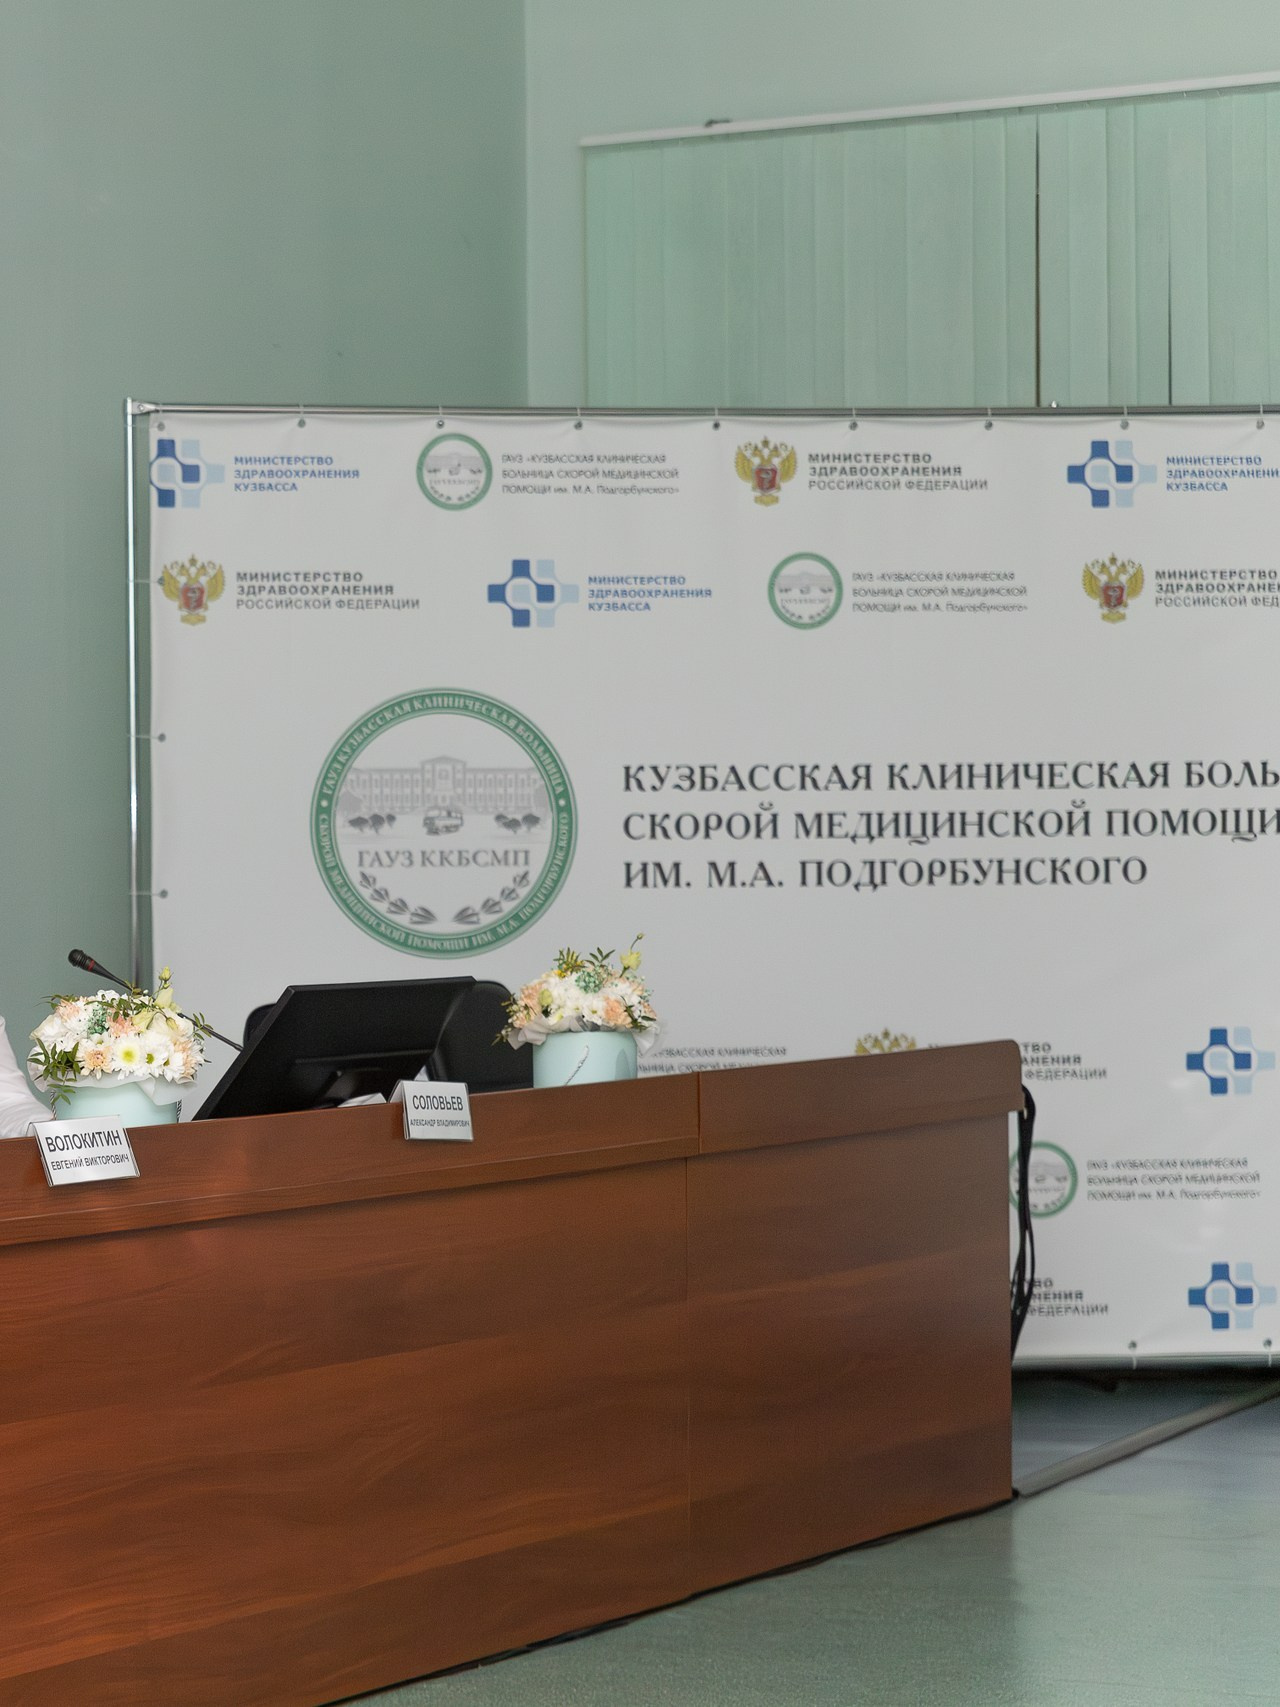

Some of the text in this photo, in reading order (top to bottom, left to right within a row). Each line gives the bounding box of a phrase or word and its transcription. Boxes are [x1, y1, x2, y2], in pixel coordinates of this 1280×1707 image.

[234, 456, 334, 466] МИНИСТЕРСТВО
[597, 453, 666, 464] КЛИНИЧЕСКАЯ
[808, 453, 932, 464] МИНИСТЕРСТВО
[1166, 456, 1262, 466] МИНИСТЕРСТВО
[234, 469, 360, 480] ЗДРАВООХРАНЕНИЯ
[502, 468, 679, 480] БОЛЬНИЦА СКОРОЙ МЕДИЦИНСКОЙ
[809, 466, 962, 477] ЗДРАВООХРАНЕНИЯ
[234, 483, 298, 492] КУЗБАССА
[502, 485, 551, 495] ПОМОЩИ
[808, 478, 988, 491] РОССИЙСКОЙ ФЕДЕРАЦИИ
[1166, 482, 1228, 492] КУЗБАССА
[236, 572, 363, 582] МИНИСТЕРСТВО
[1155, 570, 1278, 580] МИНИСТЕРСТВО
[588, 576, 686, 586] МИНИСТЕРСТВО
[237, 585, 394, 596] ЗДРАВООХРАНЕНИЯ
[588, 589, 712, 599] ЗДРАВООХРАНЕНИЯ
[236, 597, 420, 610] РОССИЙСКОЙ ФЕДЕРАЦИИ
[588, 602, 651, 612] КУЗБАССА
[1155, 595, 1247, 608] РОССИЙСКОЙ
[622, 760, 1280, 792] КУЗБАССКАЯ КЛИНИЧЕСКАЯ БОЛЬ
[623, 799, 1280, 845] СКОРОЙ МЕДИЦИНСКОЙ ПОМОЩИ
[357, 849, 530, 868] ГАУЗ ККБСМП
[624, 856, 1148, 893] ИМ. М.А. ПОДГОРБУНСКОГО
[1025, 1069, 1107, 1082] ФЕДЕРАЦИИ
[412, 1095, 464, 1111] СОЛОВЬЕВ
[45, 1130, 123, 1152] ВОЛОКИТИН
[51, 1153, 130, 1171] ЕВГЕНИЙ ВИКТОРОВИЧ
